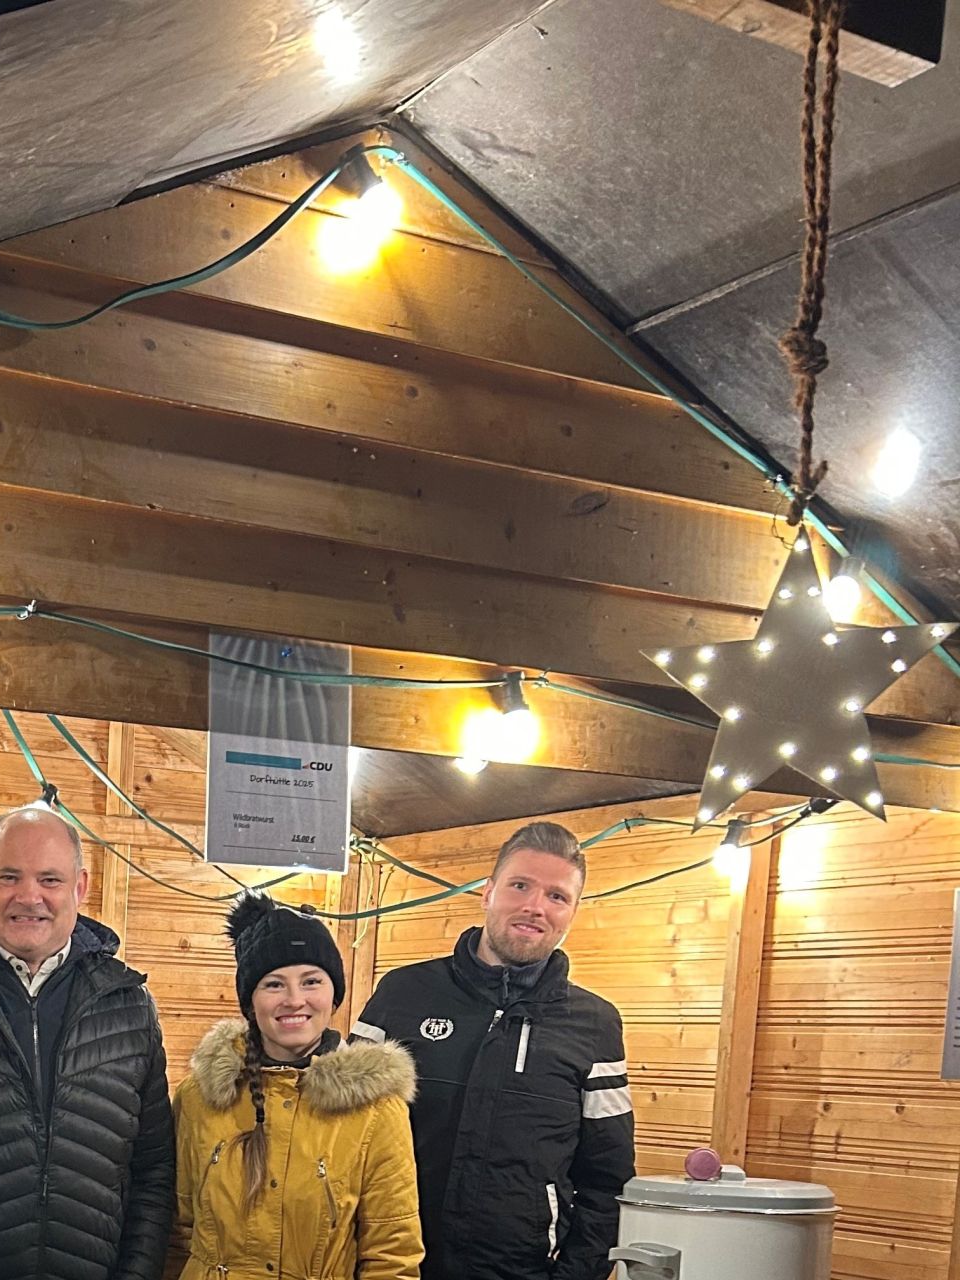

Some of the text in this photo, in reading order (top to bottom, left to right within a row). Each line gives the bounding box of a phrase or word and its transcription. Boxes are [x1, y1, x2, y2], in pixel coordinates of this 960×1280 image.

[308, 761, 333, 772] CDU
[293, 779, 315, 788] 2025
[232, 813, 275, 824] Wildbratwurst
